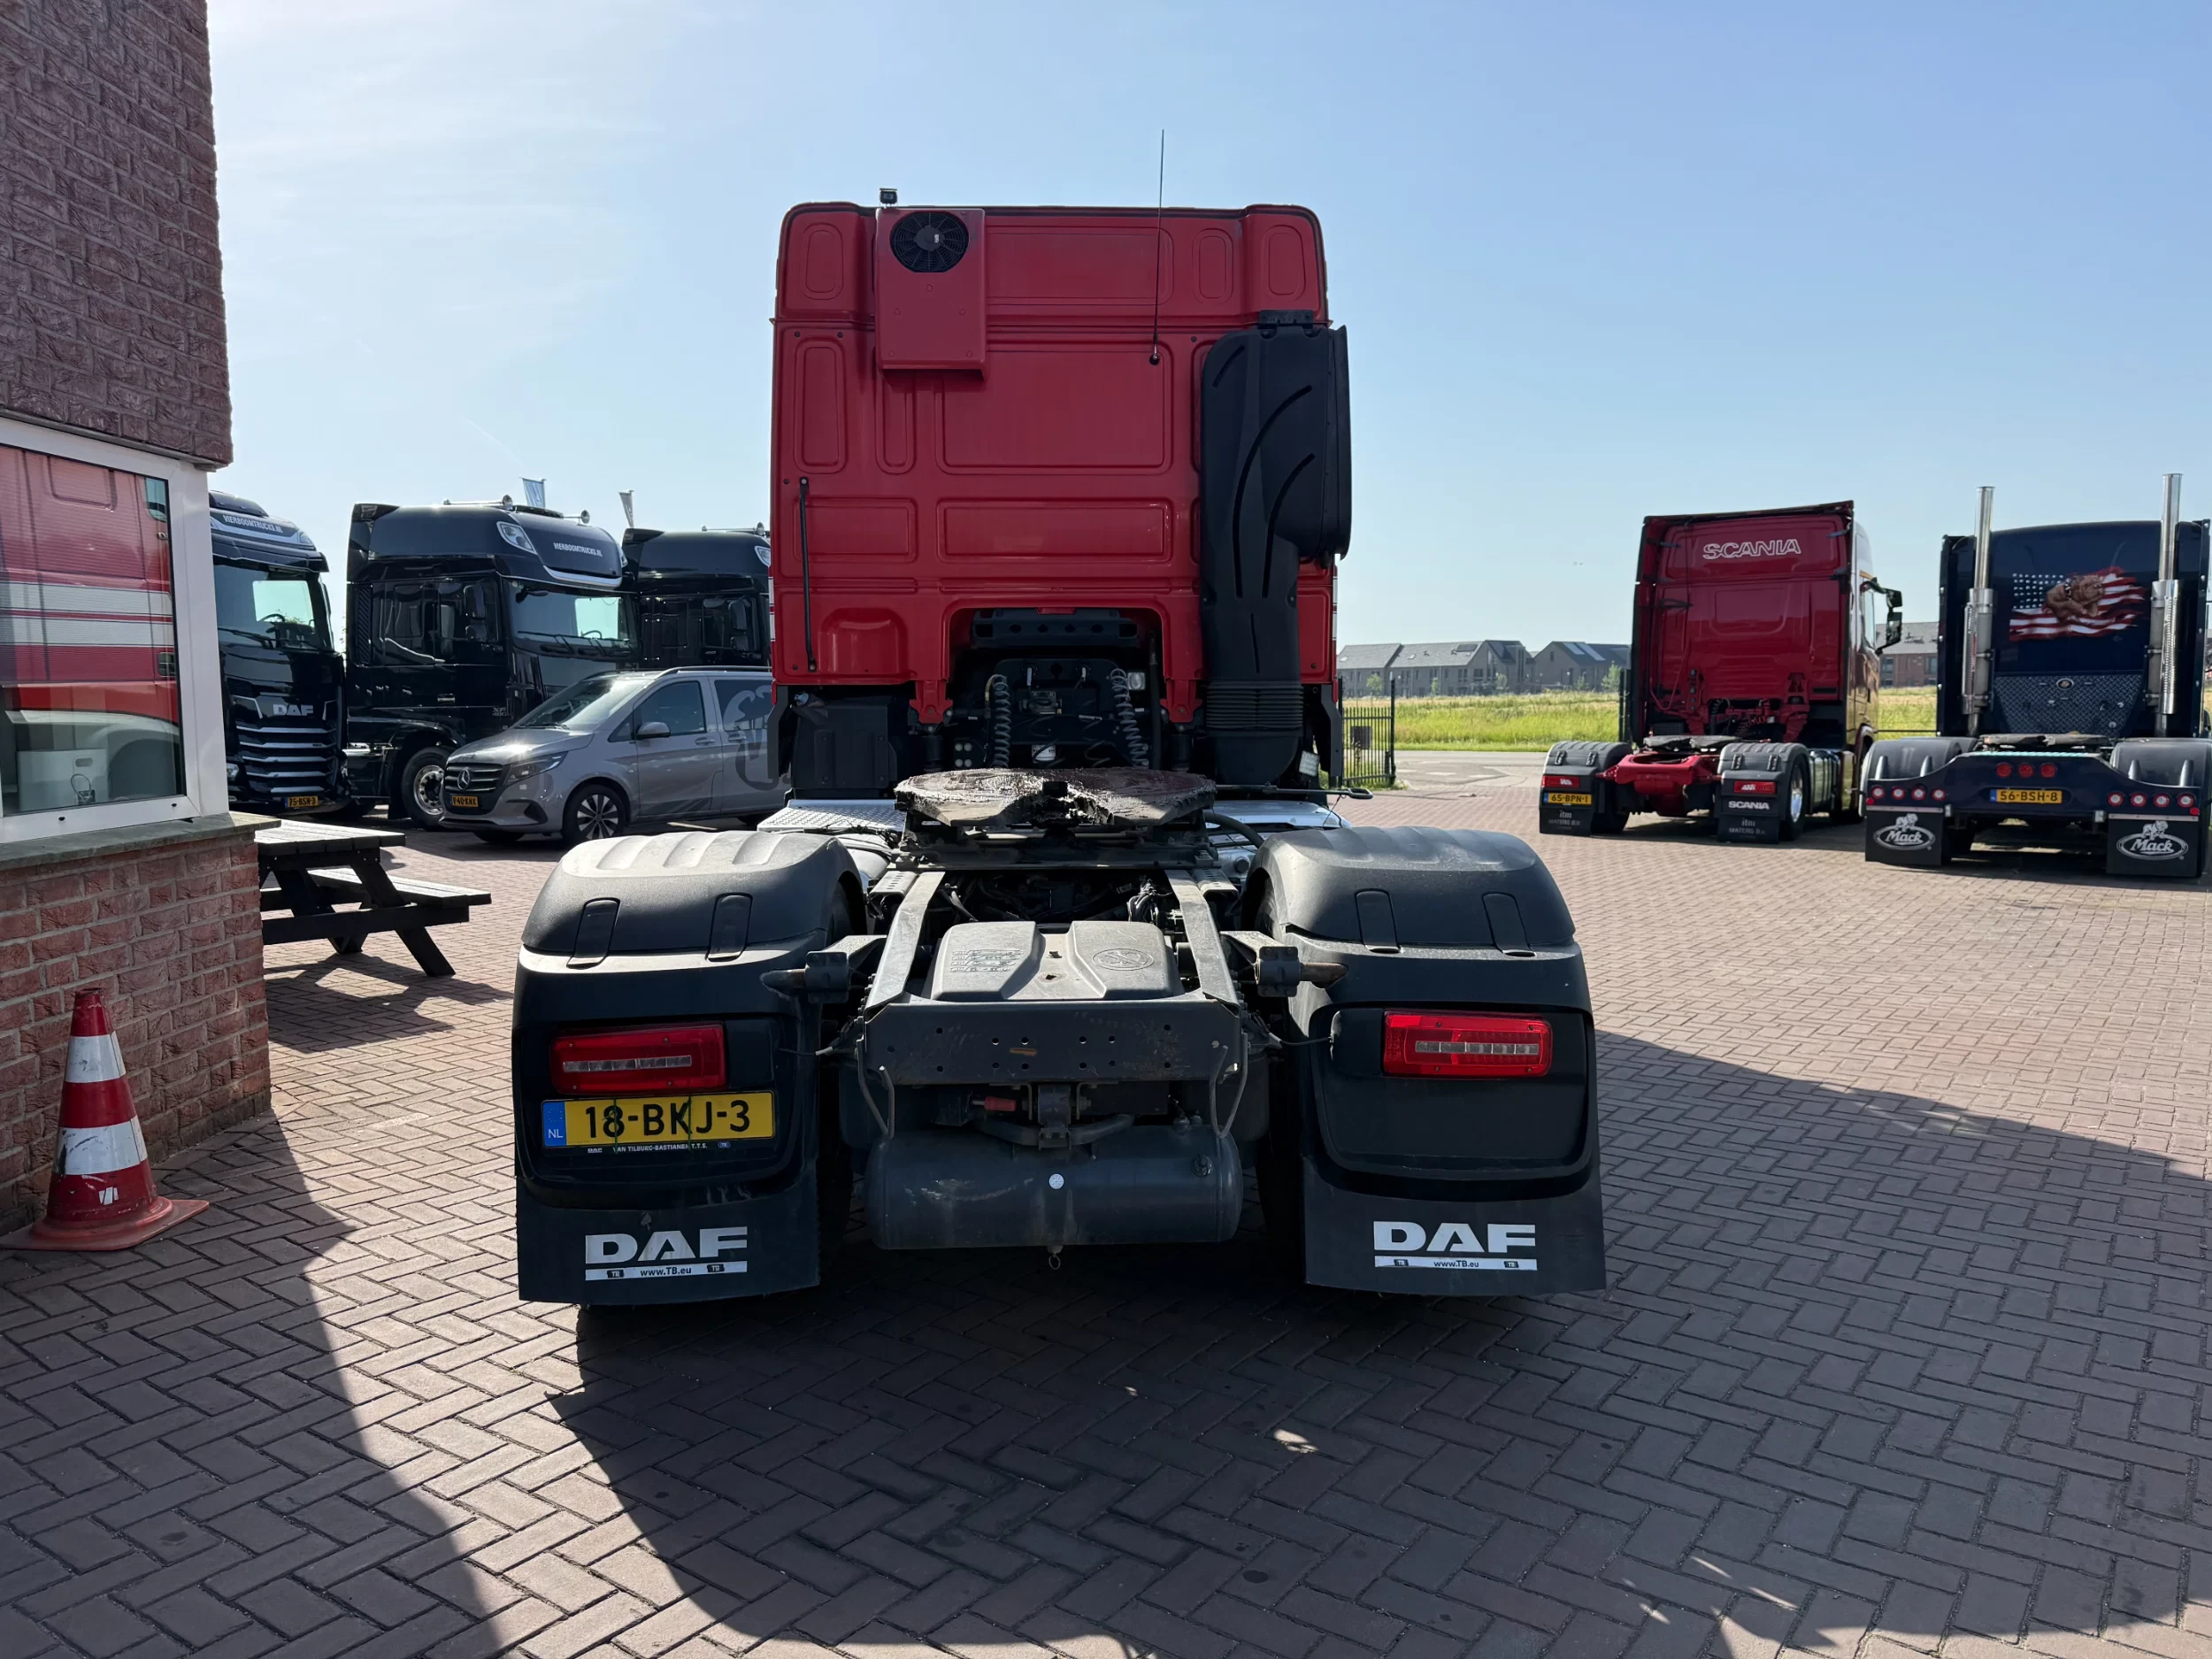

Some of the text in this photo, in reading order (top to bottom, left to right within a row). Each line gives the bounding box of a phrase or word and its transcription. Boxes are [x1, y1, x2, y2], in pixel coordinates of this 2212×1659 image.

[222, 514, 283, 534] VIERBOOMTRUCKS.NL
[1702, 539, 1801, 559] SCANIA
[273, 703, 314, 717] DAF
[1551, 794, 1588, 803] 65-BPN-1
[2000, 791, 2058, 802] 56-BSH-8
[1728, 800, 1770, 810] SCANIA
[1885, 830, 1924, 845] Mack
[2130, 839, 2175, 855] Mack
[585, 1099, 750, 1139] 18-BKJ-3
[548, 1128, 563, 1139] NL
[1373, 1221, 1536, 1253] DAF
[586, 1226, 748, 1264] DAF
[640, 1266, 692, 1277] www.TB.eu
